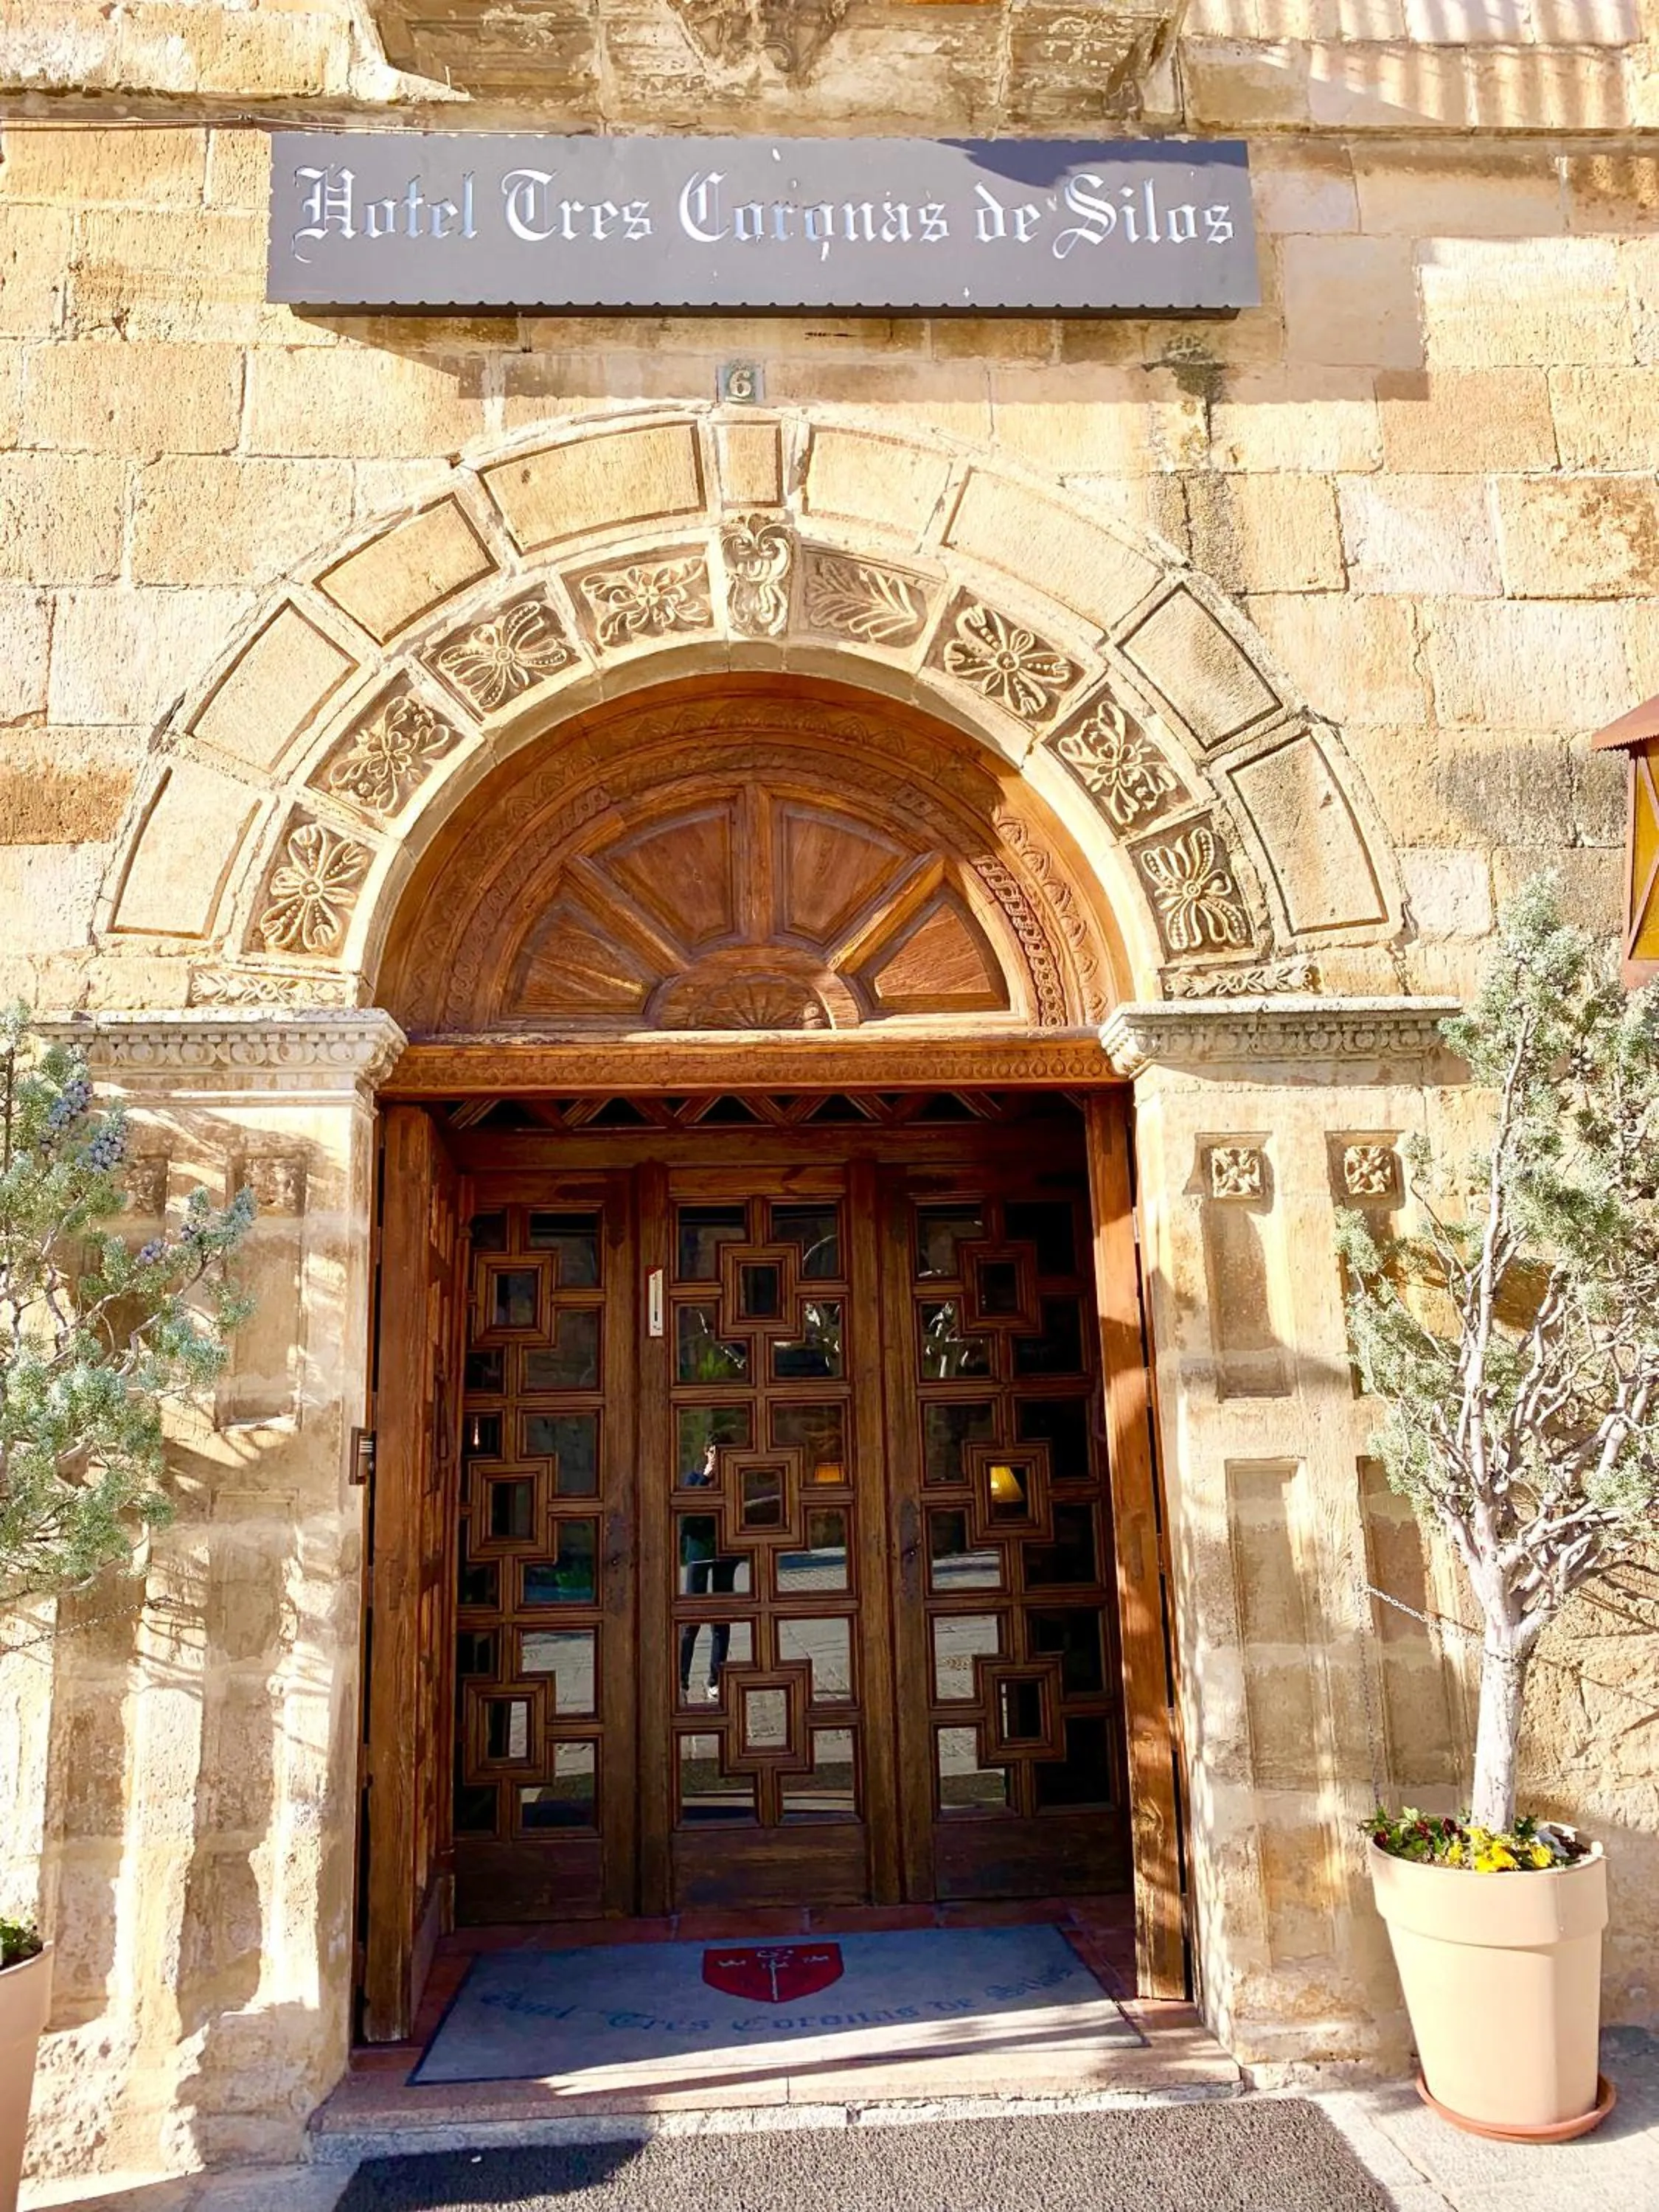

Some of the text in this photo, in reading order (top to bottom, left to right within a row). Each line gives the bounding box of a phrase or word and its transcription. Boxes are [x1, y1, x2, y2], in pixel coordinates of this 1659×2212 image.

[292, 164, 1236, 264] Hotel Tres Coronas de Silos
[729, 369, 752, 397] 6
